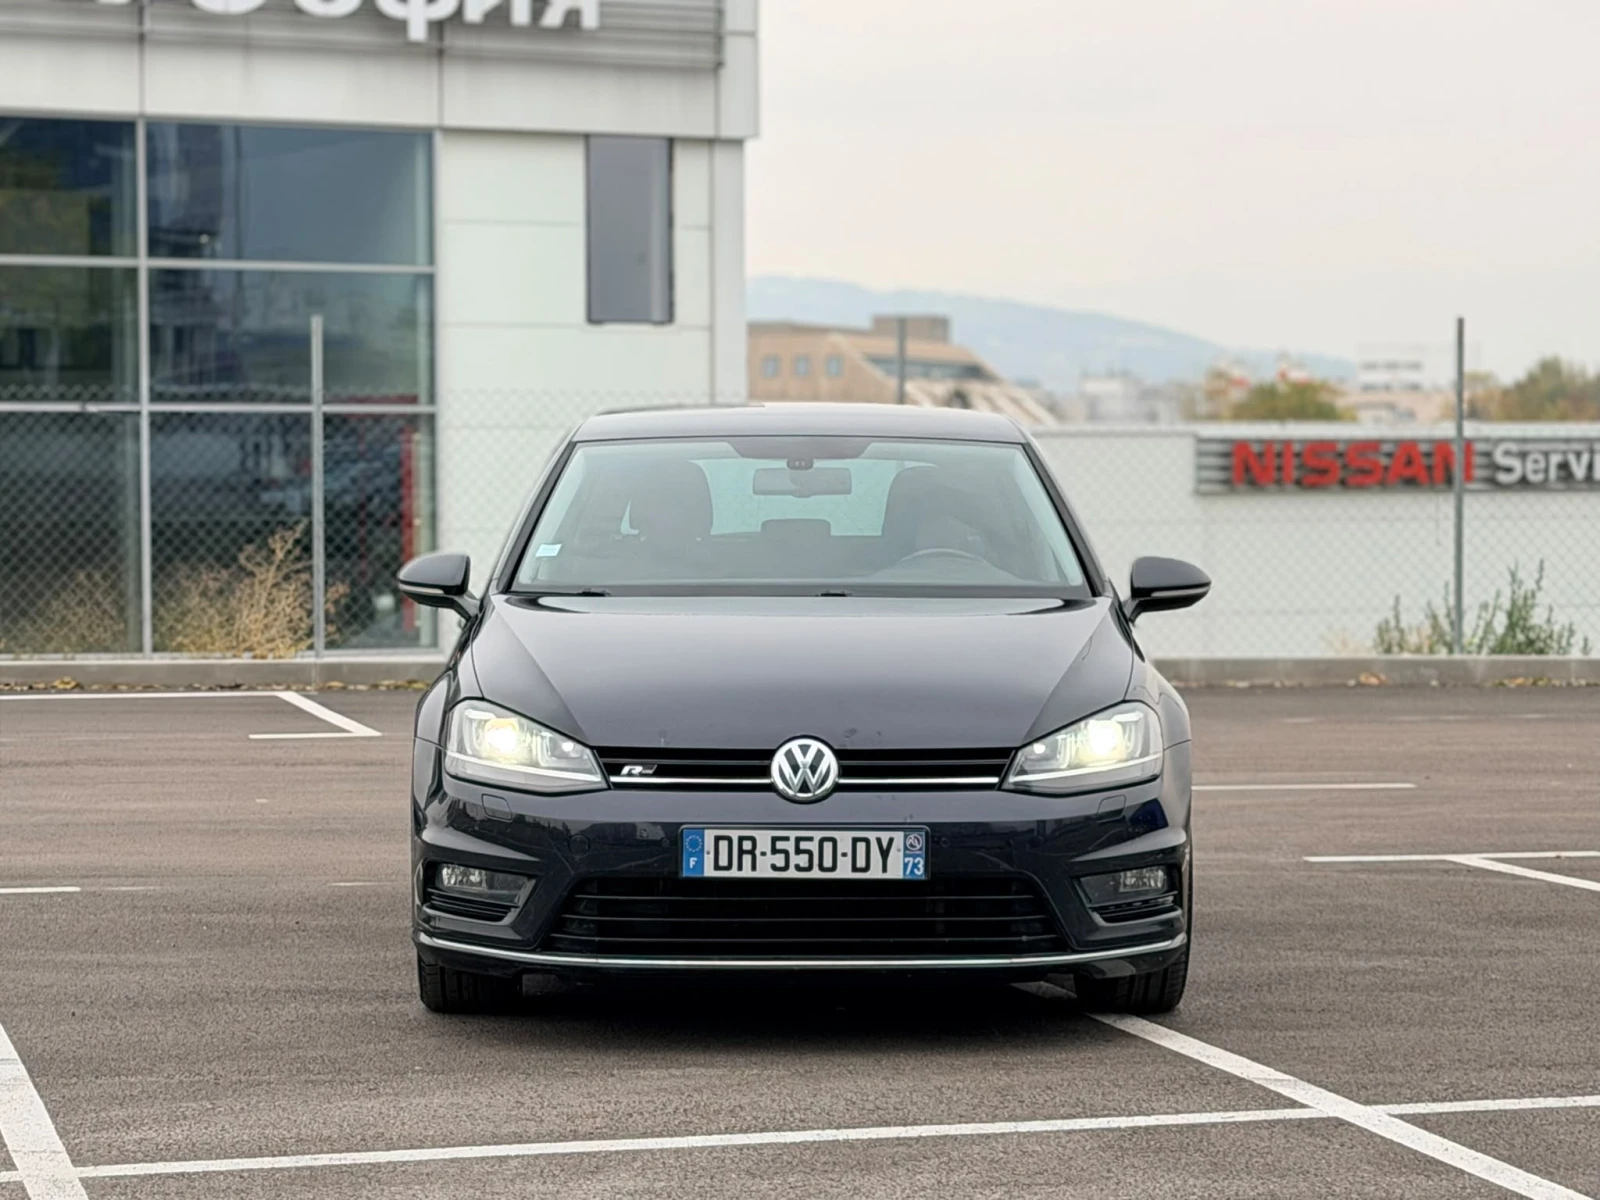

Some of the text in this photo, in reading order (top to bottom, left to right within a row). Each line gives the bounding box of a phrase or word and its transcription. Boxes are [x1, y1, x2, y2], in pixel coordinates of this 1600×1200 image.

[1231, 439, 1475, 486] NISSAN
[689, 857, 698, 869] F
[713, 834, 895, 874] DR-550-DY
[904, 856, 924, 876] 73
